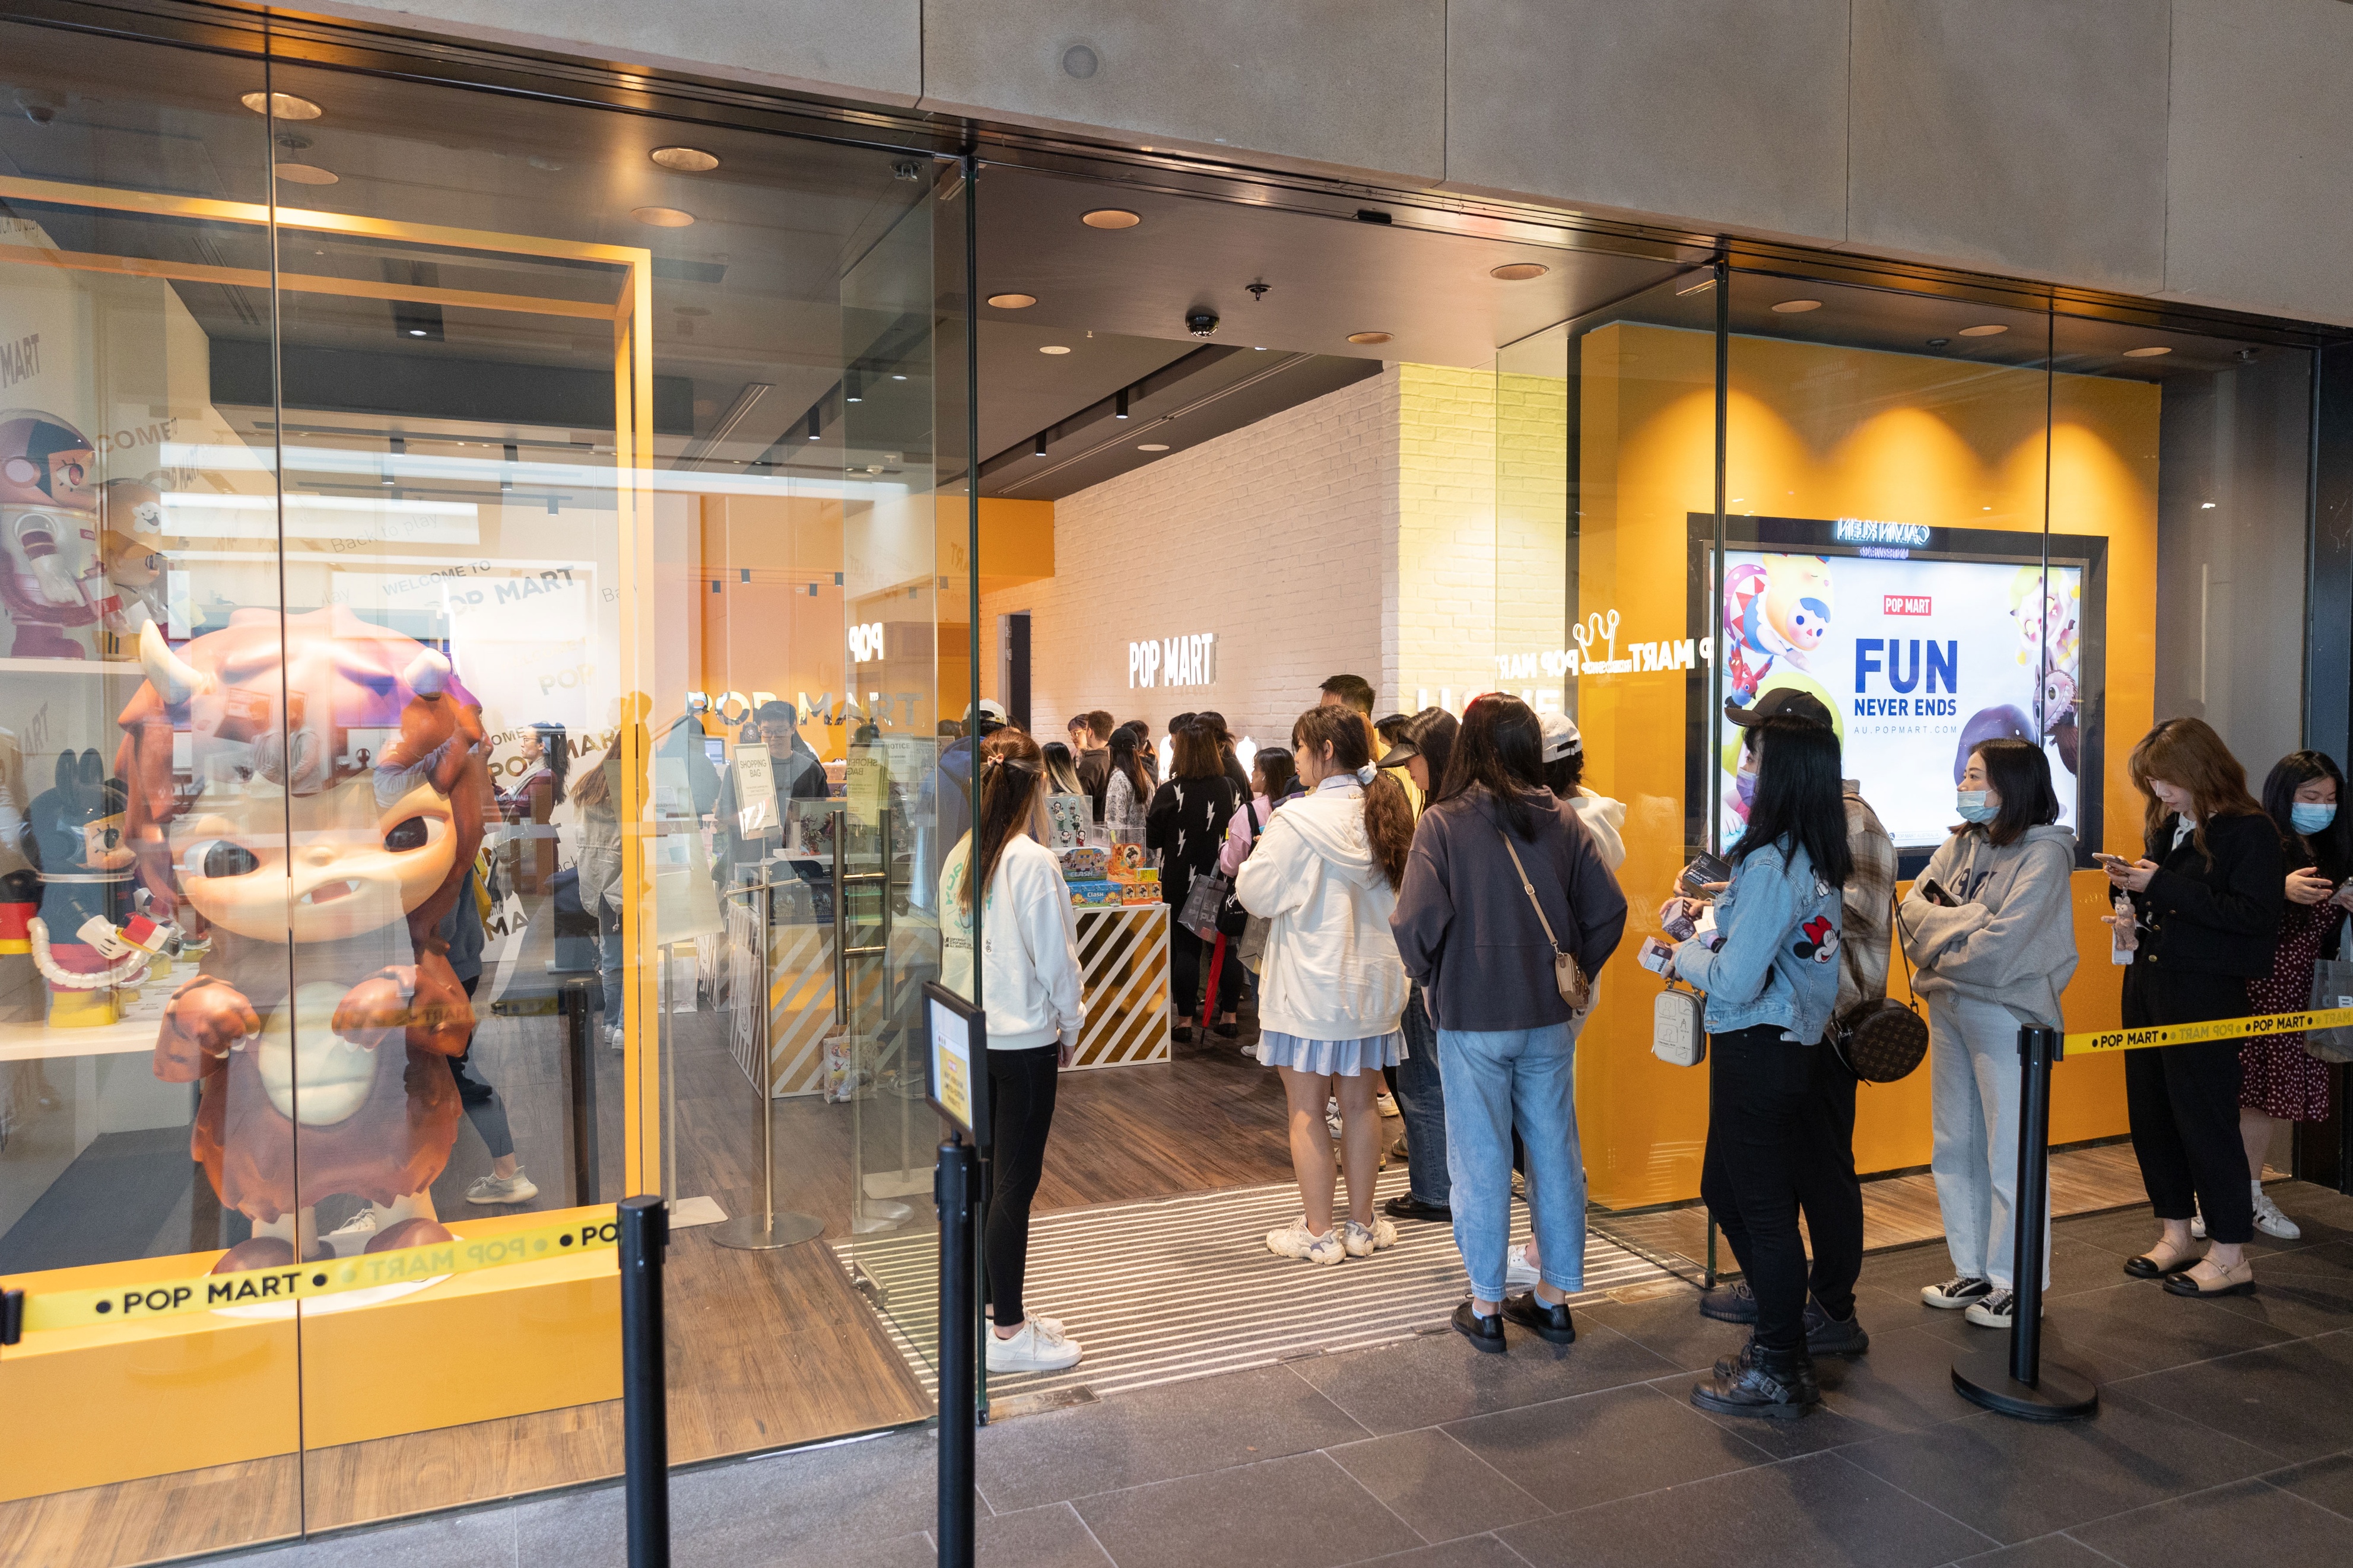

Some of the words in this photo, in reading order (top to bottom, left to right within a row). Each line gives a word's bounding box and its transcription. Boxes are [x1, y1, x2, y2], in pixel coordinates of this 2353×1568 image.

[331, 529, 377, 553] Back
[381, 525, 399, 539] to
[403, 514, 438, 535] play
[383, 566, 467, 596] WELCOME
[474, 559, 491, 574] TO
[494, 565, 576, 606] MART
[1885, 597, 1903, 613] POP
[1905, 598, 1930, 613] MART
[1129, 640, 1161, 689] POP
[1164, 632, 1214, 687] MART
[1855, 638, 1958, 694] FUN
[538, 663, 595, 696] POP
[685, 691, 779, 726] POP
[798, 691, 924, 726] MART
[1855, 698, 1909, 716] NEVER
[1914, 699, 1957, 716] ENDS
[1854, 726, 1957, 734] AU.POPMART.COM
[740, 759, 767, 769] SHOPPING
[750, 769, 761, 778] BAG
[2100, 1033, 2123, 1048] POP
[2126, 1030, 2159, 1045] MART
[2253, 1017, 2273, 1032] POP
[2276, 1015, 2306, 1029] MART
[123, 1286, 193, 1314] POP
[207, 1271, 301, 1304] MART
